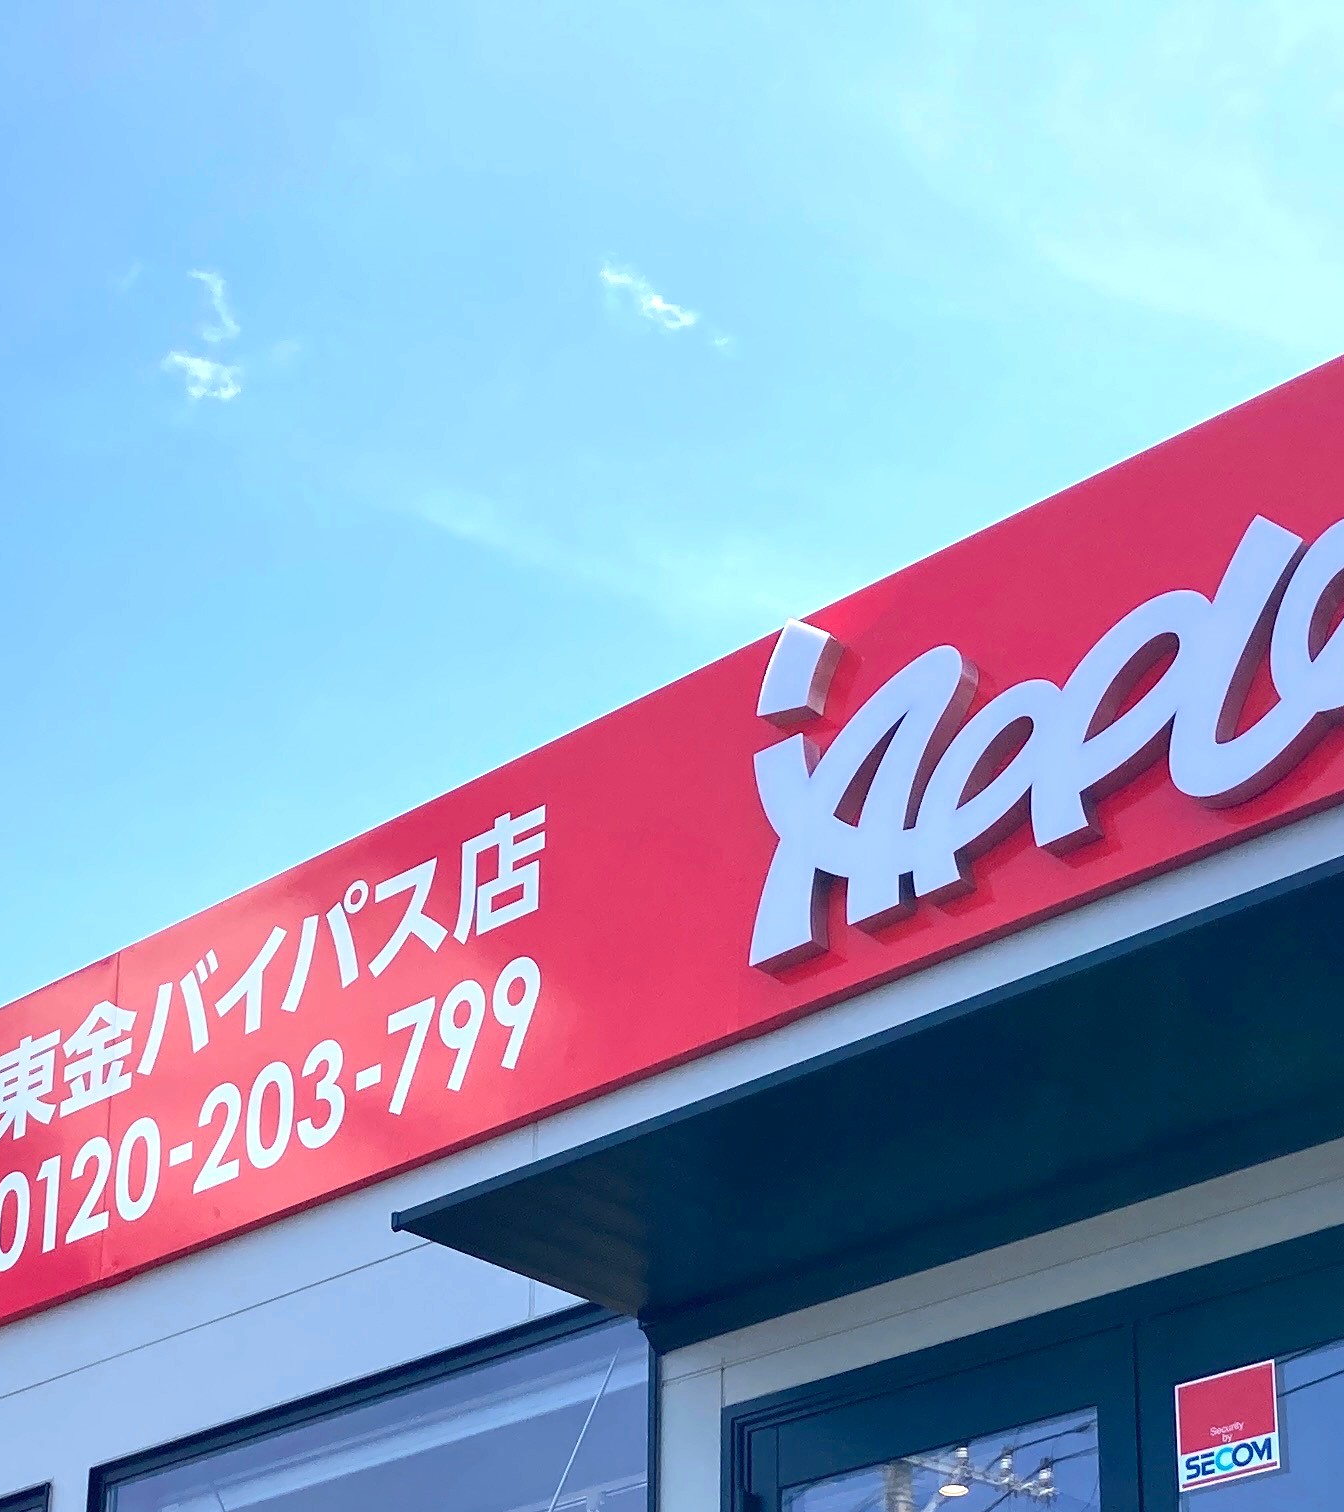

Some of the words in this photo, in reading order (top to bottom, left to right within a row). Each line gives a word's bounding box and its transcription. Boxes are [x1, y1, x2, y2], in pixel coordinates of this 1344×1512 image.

[1209, 1421, 1244, 1437] Security
[1221, 1434, 1233, 1443] by
[1185, 1437, 1272, 1480] SECOM
